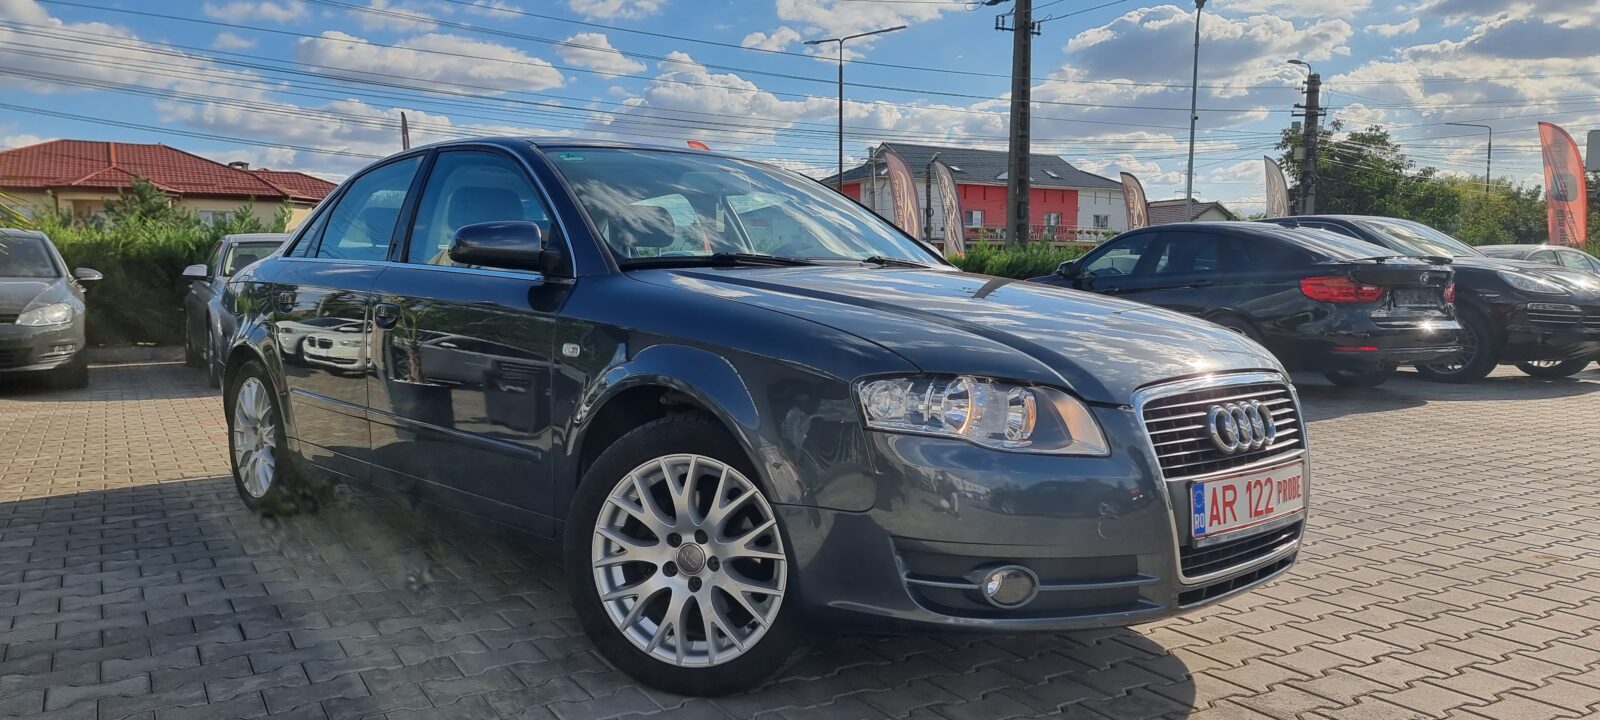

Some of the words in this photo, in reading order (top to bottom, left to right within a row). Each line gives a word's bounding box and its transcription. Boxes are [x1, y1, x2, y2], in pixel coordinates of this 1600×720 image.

[1208, 484, 1238, 527] AR
[1246, 477, 1274, 518] 122
[1277, 475, 1301, 505] PROBE
[1194, 512, 1205, 530] RO
